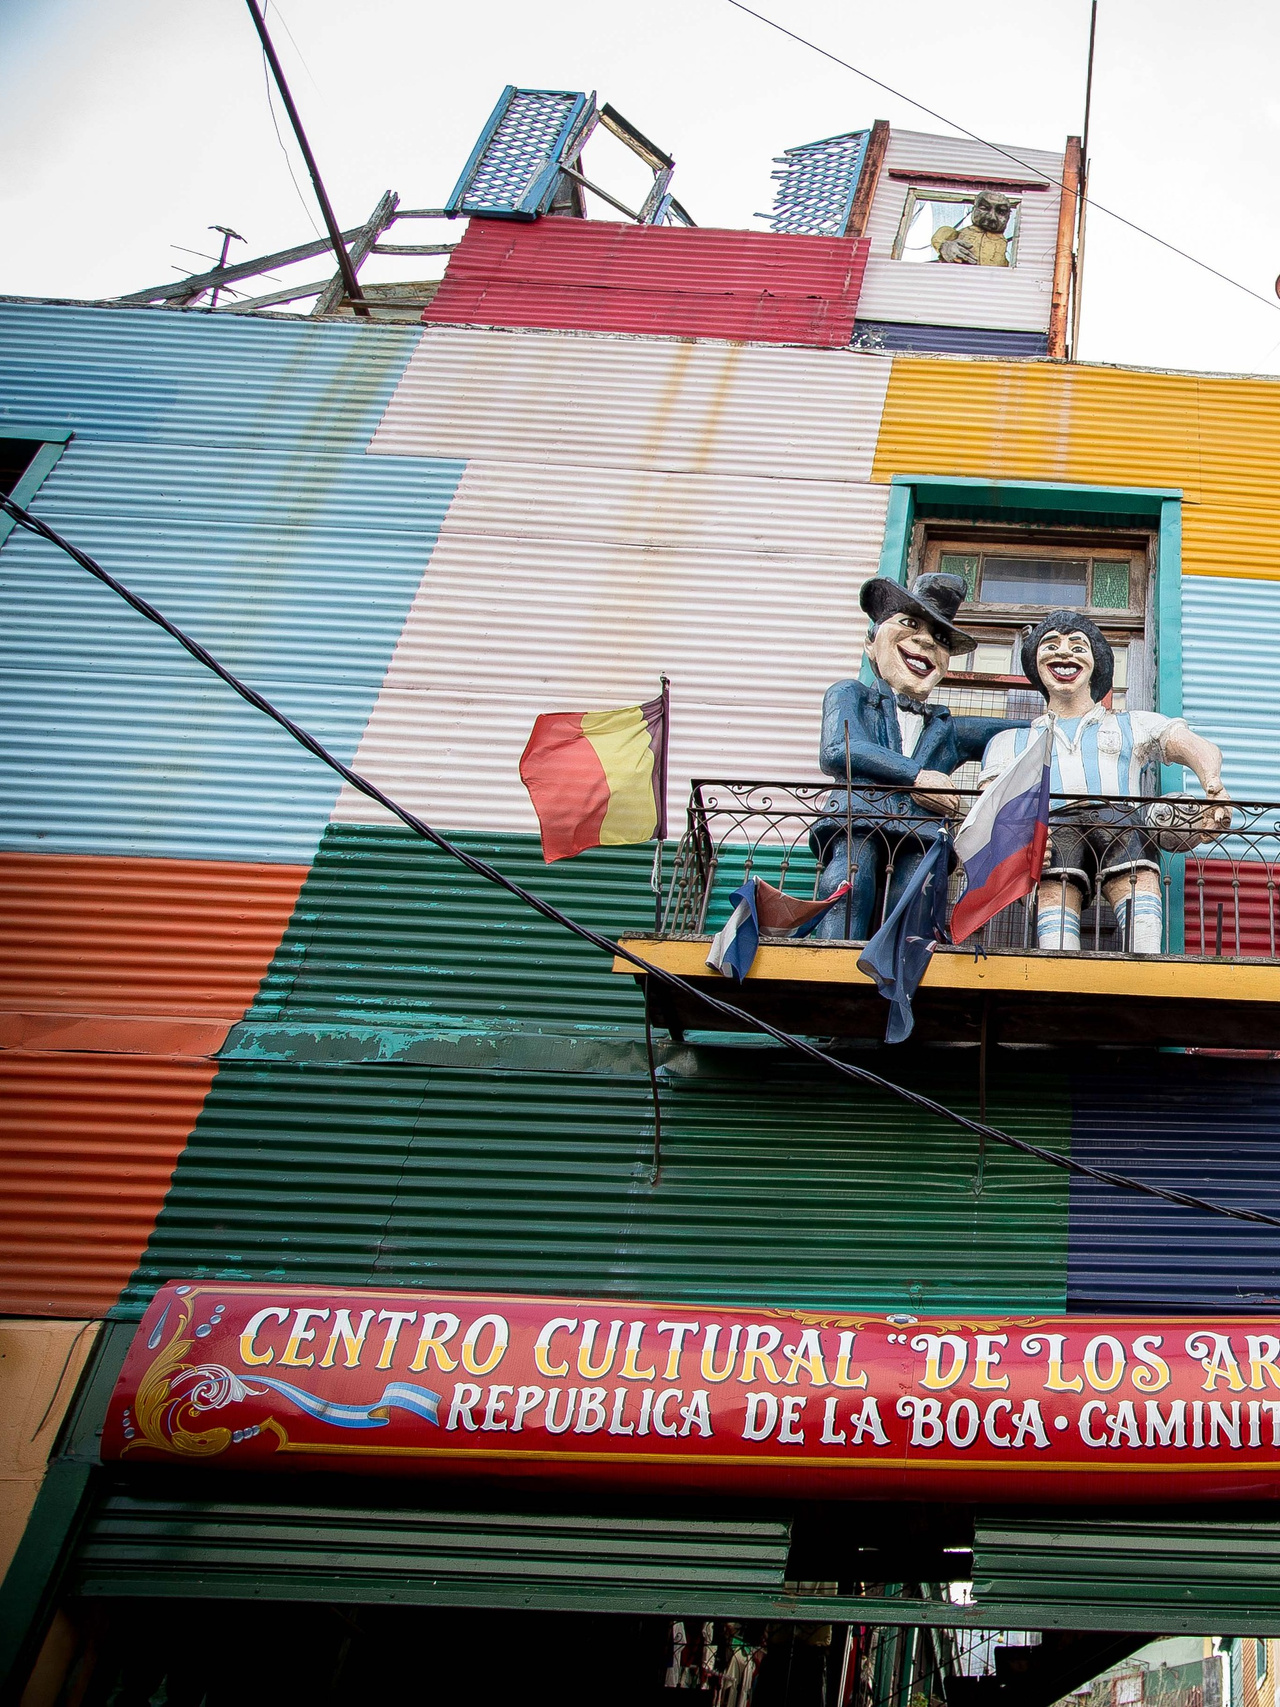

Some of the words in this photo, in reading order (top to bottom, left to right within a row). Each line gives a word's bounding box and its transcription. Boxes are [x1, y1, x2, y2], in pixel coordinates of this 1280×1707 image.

[239, 1307, 509, 1376] CENTRO
[533, 1317, 869, 1389] CULTURAL
[1021, 1333, 1173, 1394] LOS
[445, 1382, 714, 1439] REPUBLICA
[742, 1392, 808, 1445] DE
[819, 1396, 891, 1446] LA
[896, 1395, 1051, 1448] BOCA
